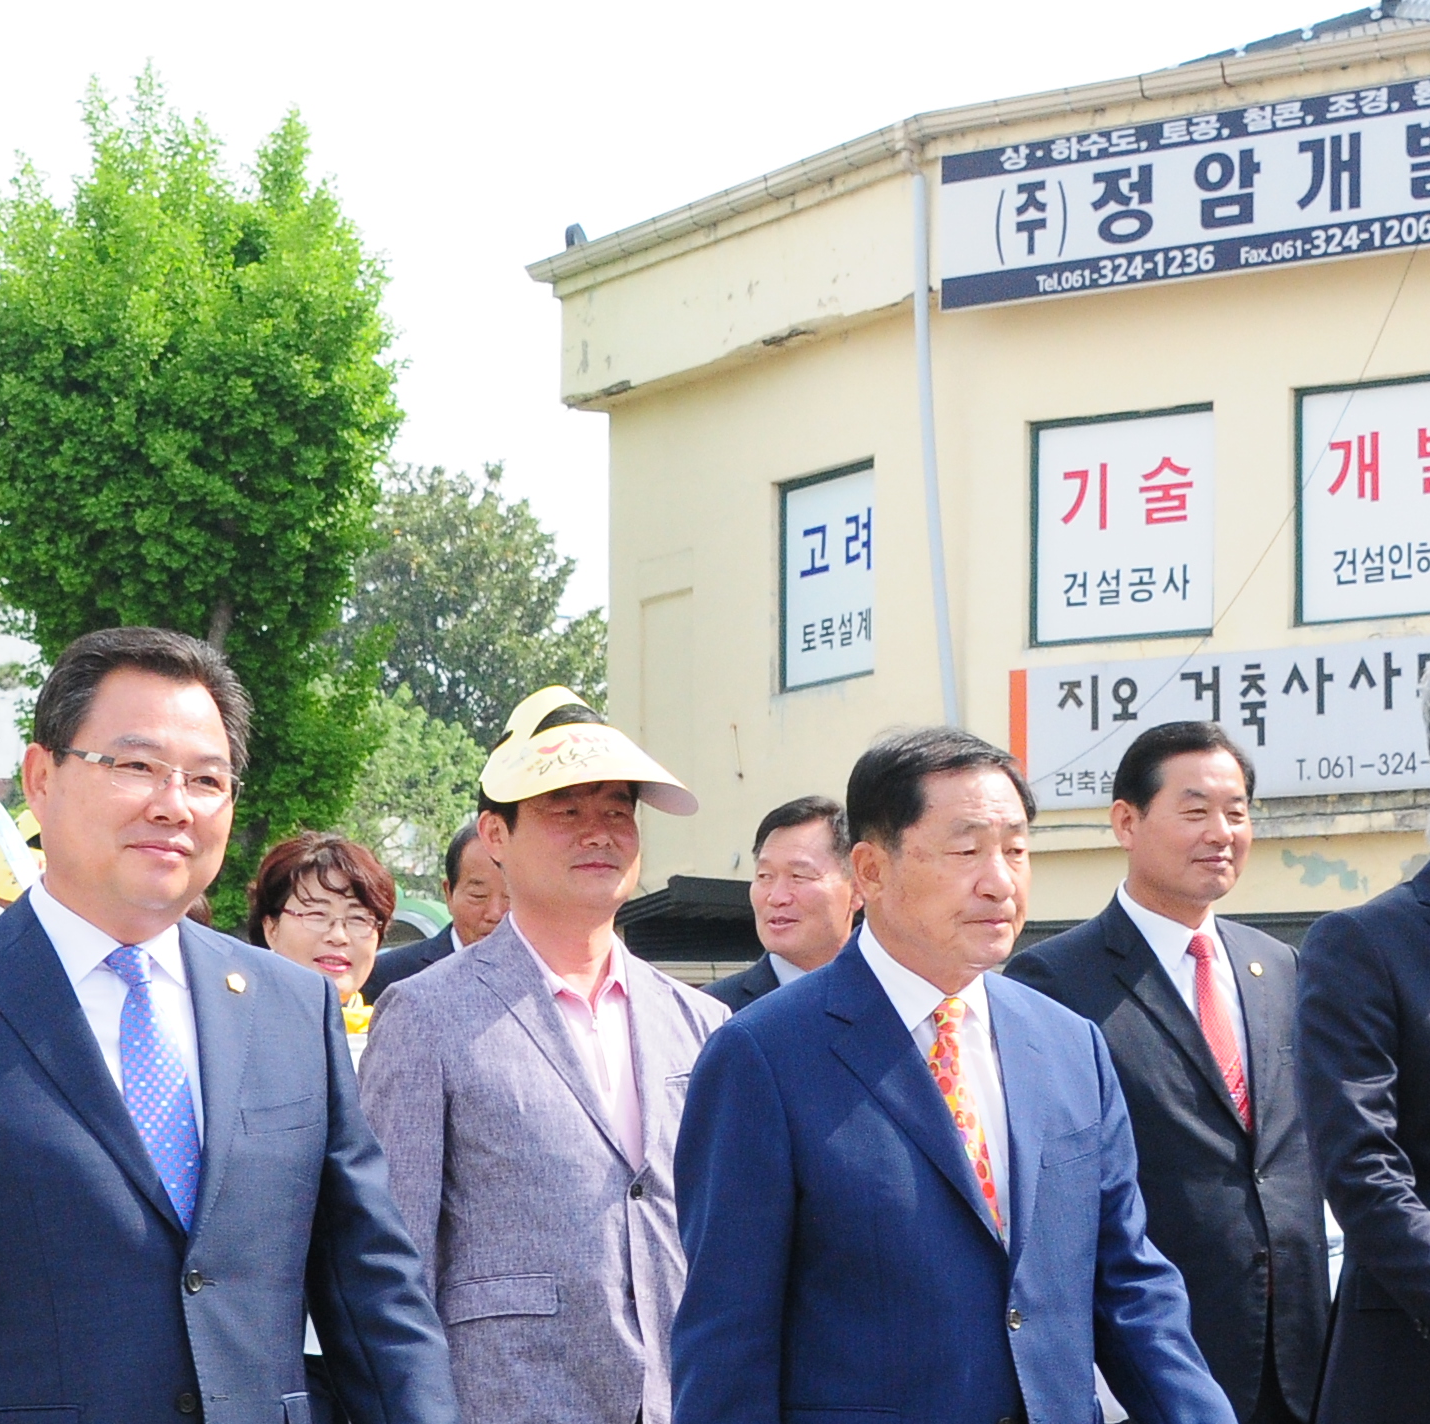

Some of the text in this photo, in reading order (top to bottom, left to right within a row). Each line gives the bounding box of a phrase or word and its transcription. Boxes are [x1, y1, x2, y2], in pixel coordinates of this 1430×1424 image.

[1061, 456, 1195, 531] 기술
[800, 507, 872, 578] 고려
[1062, 563, 1191, 608] 건설공사
[801, 607, 872, 653] 토목설계
[1057, 675, 1139, 731] 지오
[1318, 751, 1430, 780] 061-324-
